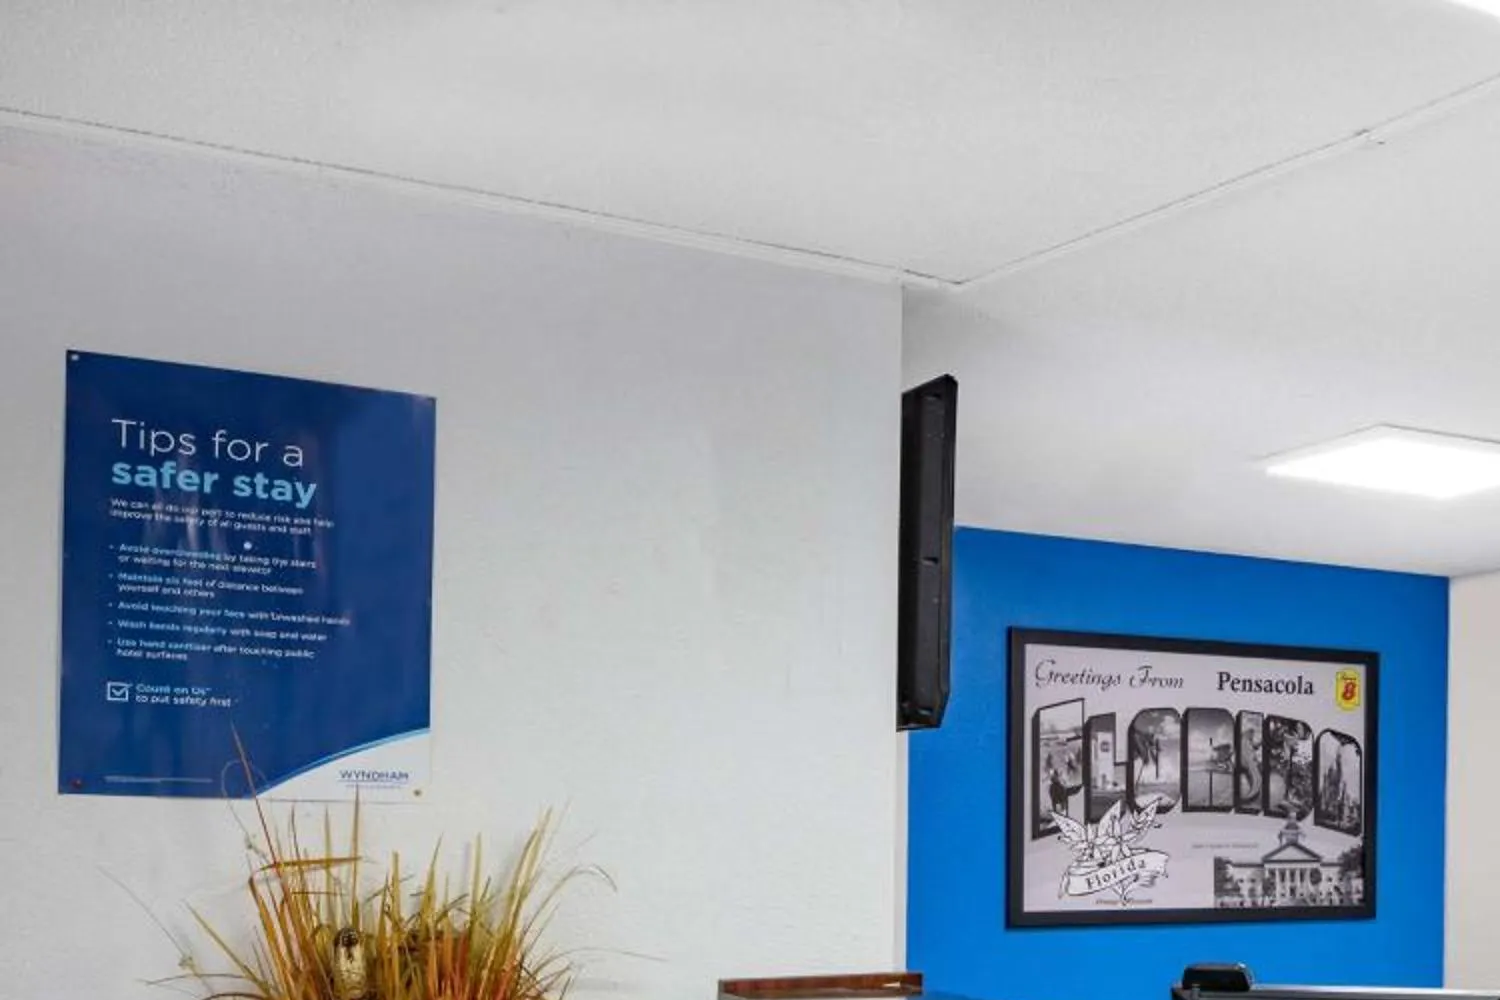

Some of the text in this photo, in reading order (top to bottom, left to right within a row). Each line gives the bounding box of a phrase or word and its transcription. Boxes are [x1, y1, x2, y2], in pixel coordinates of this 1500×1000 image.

[111, 418, 304, 467] Tips for a
[111, 460, 317, 509] safer stay
[111, 498, 128, 507] We
[130, 501, 149, 510] can
[238, 511, 271, 521] reduce
[273, 515, 290, 524] risk
[154, 512, 171, 521] the
[233, 522, 266, 532] guests
[268, 525, 287, 533] and
[119, 543, 150, 553] Avoid
[239, 554, 270, 566] taking
[133, 556, 171, 568] waiting
[172, 558, 187, 567] for
[189, 559, 207, 569] the
[161, 587, 181, 595] and
[182, 588, 215, 599] others
[205, 579, 217, 588] of
[117, 601, 149, 611] Avoid
[150, 604, 197, 616] touching
[199, 607, 221, 618] your
[223, 608, 245, 619] face
[247, 611, 269, 620] with
[117, 619, 147, 629] Wash
[182, 625, 228, 636] regularly
[228, 628, 251, 637] with
[279, 631, 299, 640] and
[117, 637, 137, 647] Use
[139, 639, 166, 649] hand
[213, 644, 237, 654] after
[1034, 659, 1315, 696] Greetings From Pensacola
[135, 683, 171, 694] Count
[173, 686, 189, 695] on
[1342, 680, 1356, 701] 8
[135, 695, 148, 703] to
[151, 695, 171, 705] put
[173, 696, 207, 708] safety
[338, 769, 409, 780] WYNDHAM
[1085, 859, 1147, 889] Florida
